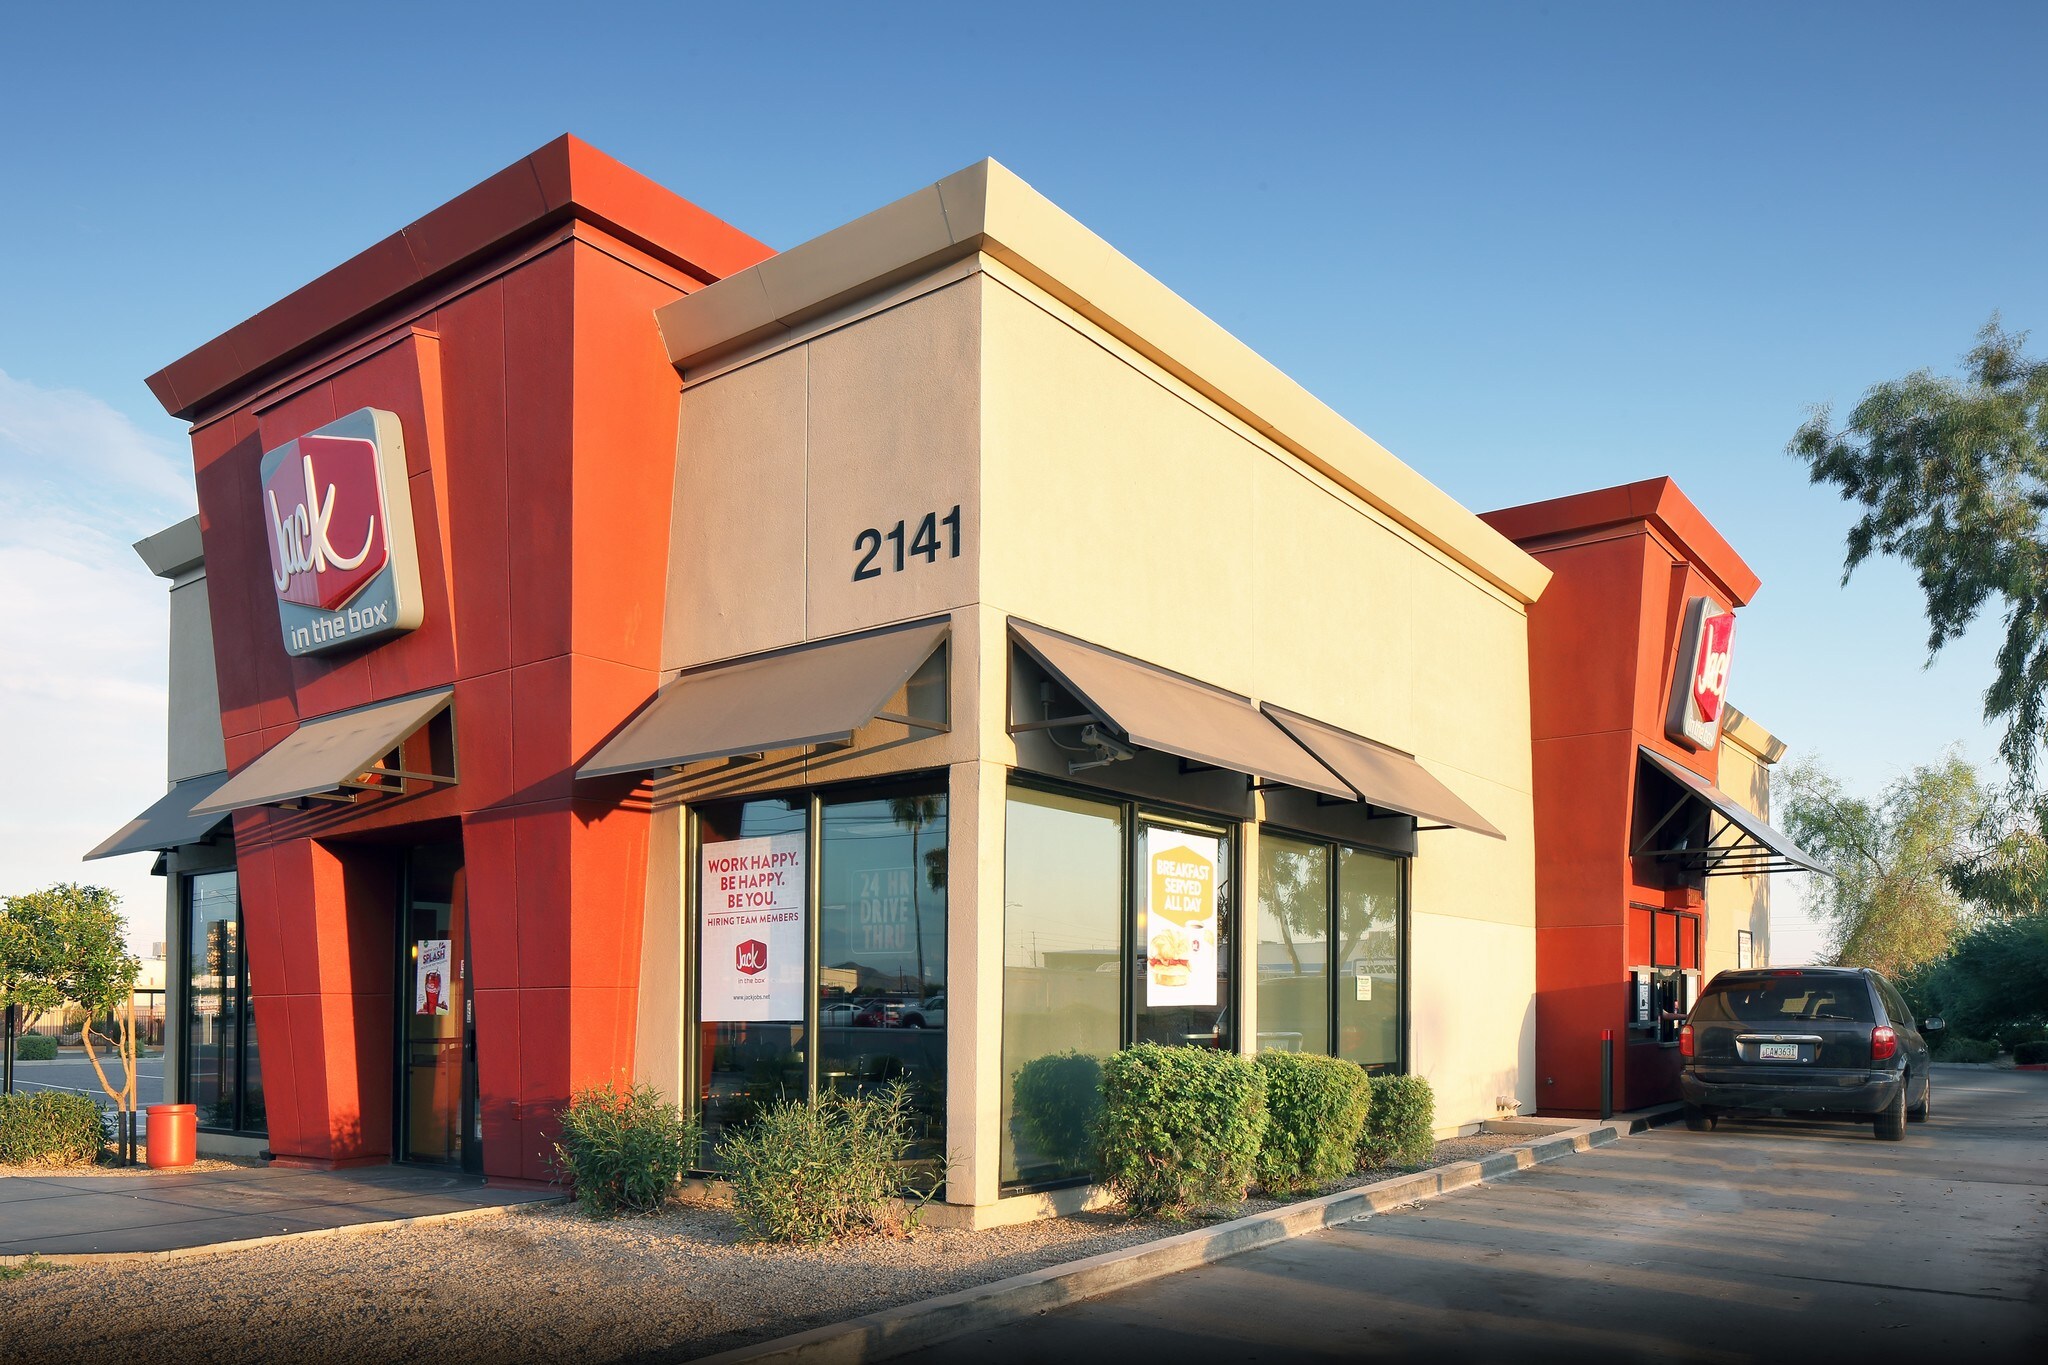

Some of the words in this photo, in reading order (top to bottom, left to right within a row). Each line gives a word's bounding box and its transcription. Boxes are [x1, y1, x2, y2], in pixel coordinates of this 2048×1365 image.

[267, 454, 375, 593] Jack
[852, 504, 961, 582] 2141
[291, 625, 310, 650] in
[312, 616, 346, 644] the
[347, 602, 388, 633] box
[708, 857, 748, 874] WORK
[750, 851, 799, 870] HAPPY.
[1156, 859, 1210, 881] BREAKFAST
[720, 875, 736, 891] BE
[738, 871, 786, 890] HAPPY.
[861, 872, 879, 897] 24
[888, 871, 909, 896] HR
[1164, 877, 1202, 896] SERVED
[728, 894, 744, 908] BE
[745, 891, 777, 907] YOU.
[861, 896, 909, 924] DRIVE
[1163, 894, 1182, 911] ALL
[1183, 895, 1202, 913] DAY
[707, 916, 735, 927] HIRING
[736, 915, 758, 925] TEAM
[759, 912, 799, 923] MEMBERS
[863, 924, 905, 949] THRU
[423, 950, 445, 964] SPLASH
[736, 943, 767, 970] Jack
[732, 994, 771, 1002] www.jackjobs.net
